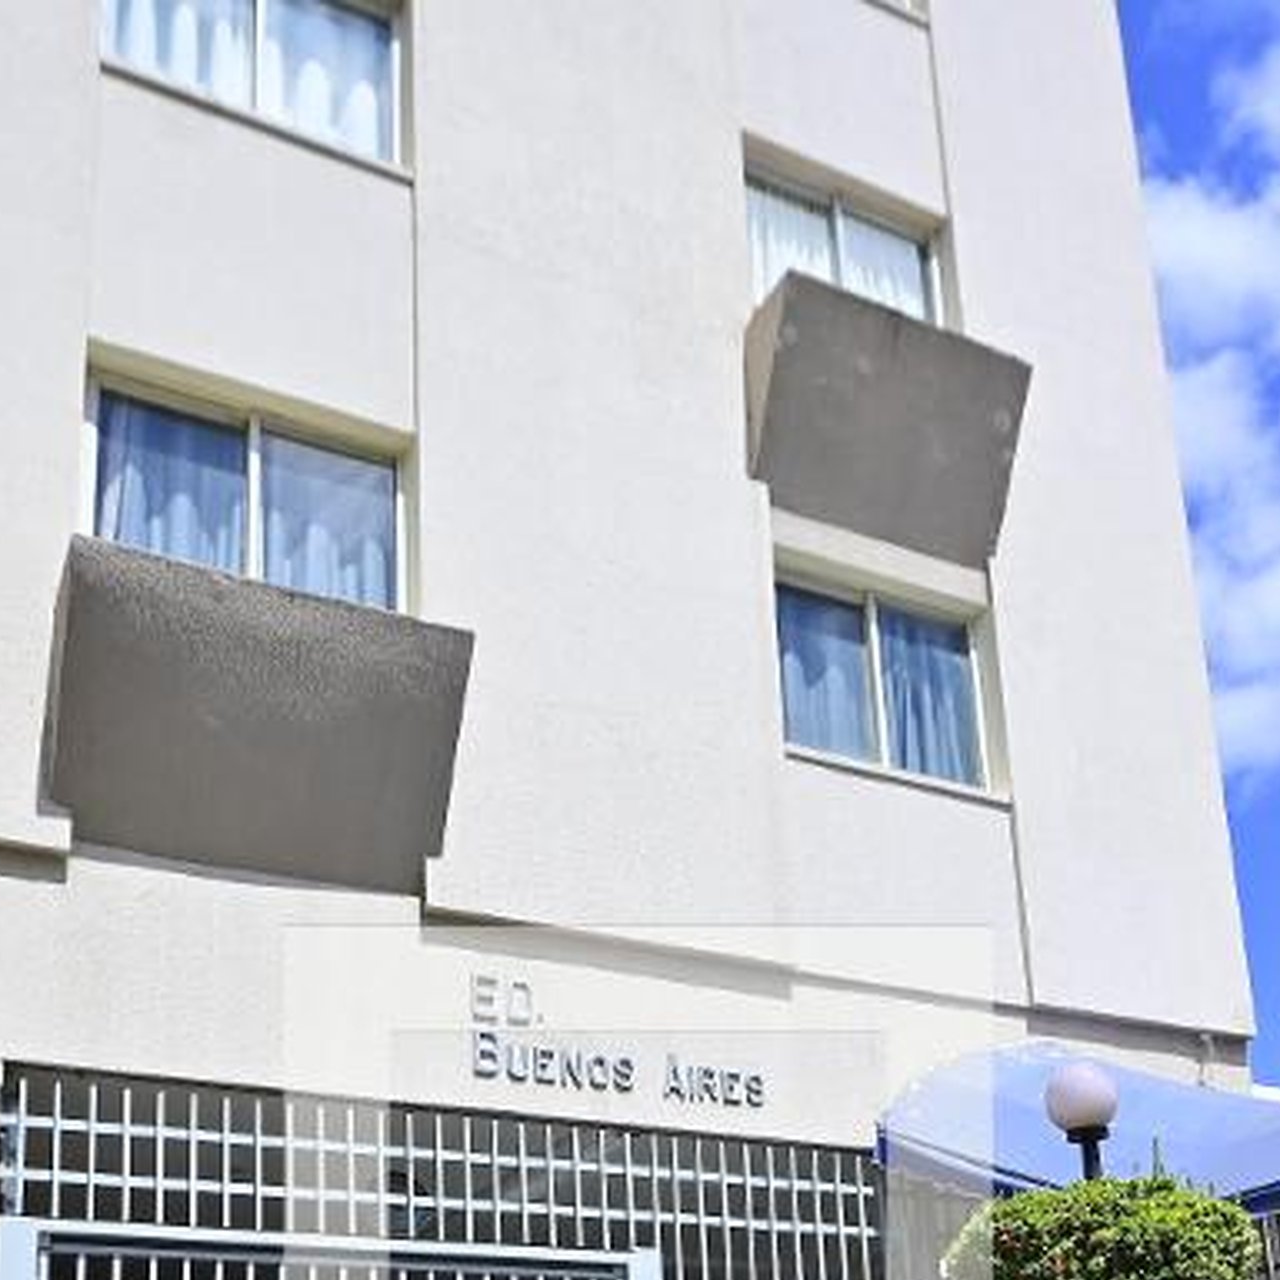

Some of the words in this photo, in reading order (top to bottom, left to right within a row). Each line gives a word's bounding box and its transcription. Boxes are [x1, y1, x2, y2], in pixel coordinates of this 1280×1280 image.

[472, 975, 543, 1027] ED.
[472, 1030, 634, 1094] BUENOS
[663, 1055, 765, 1108] AIRES
